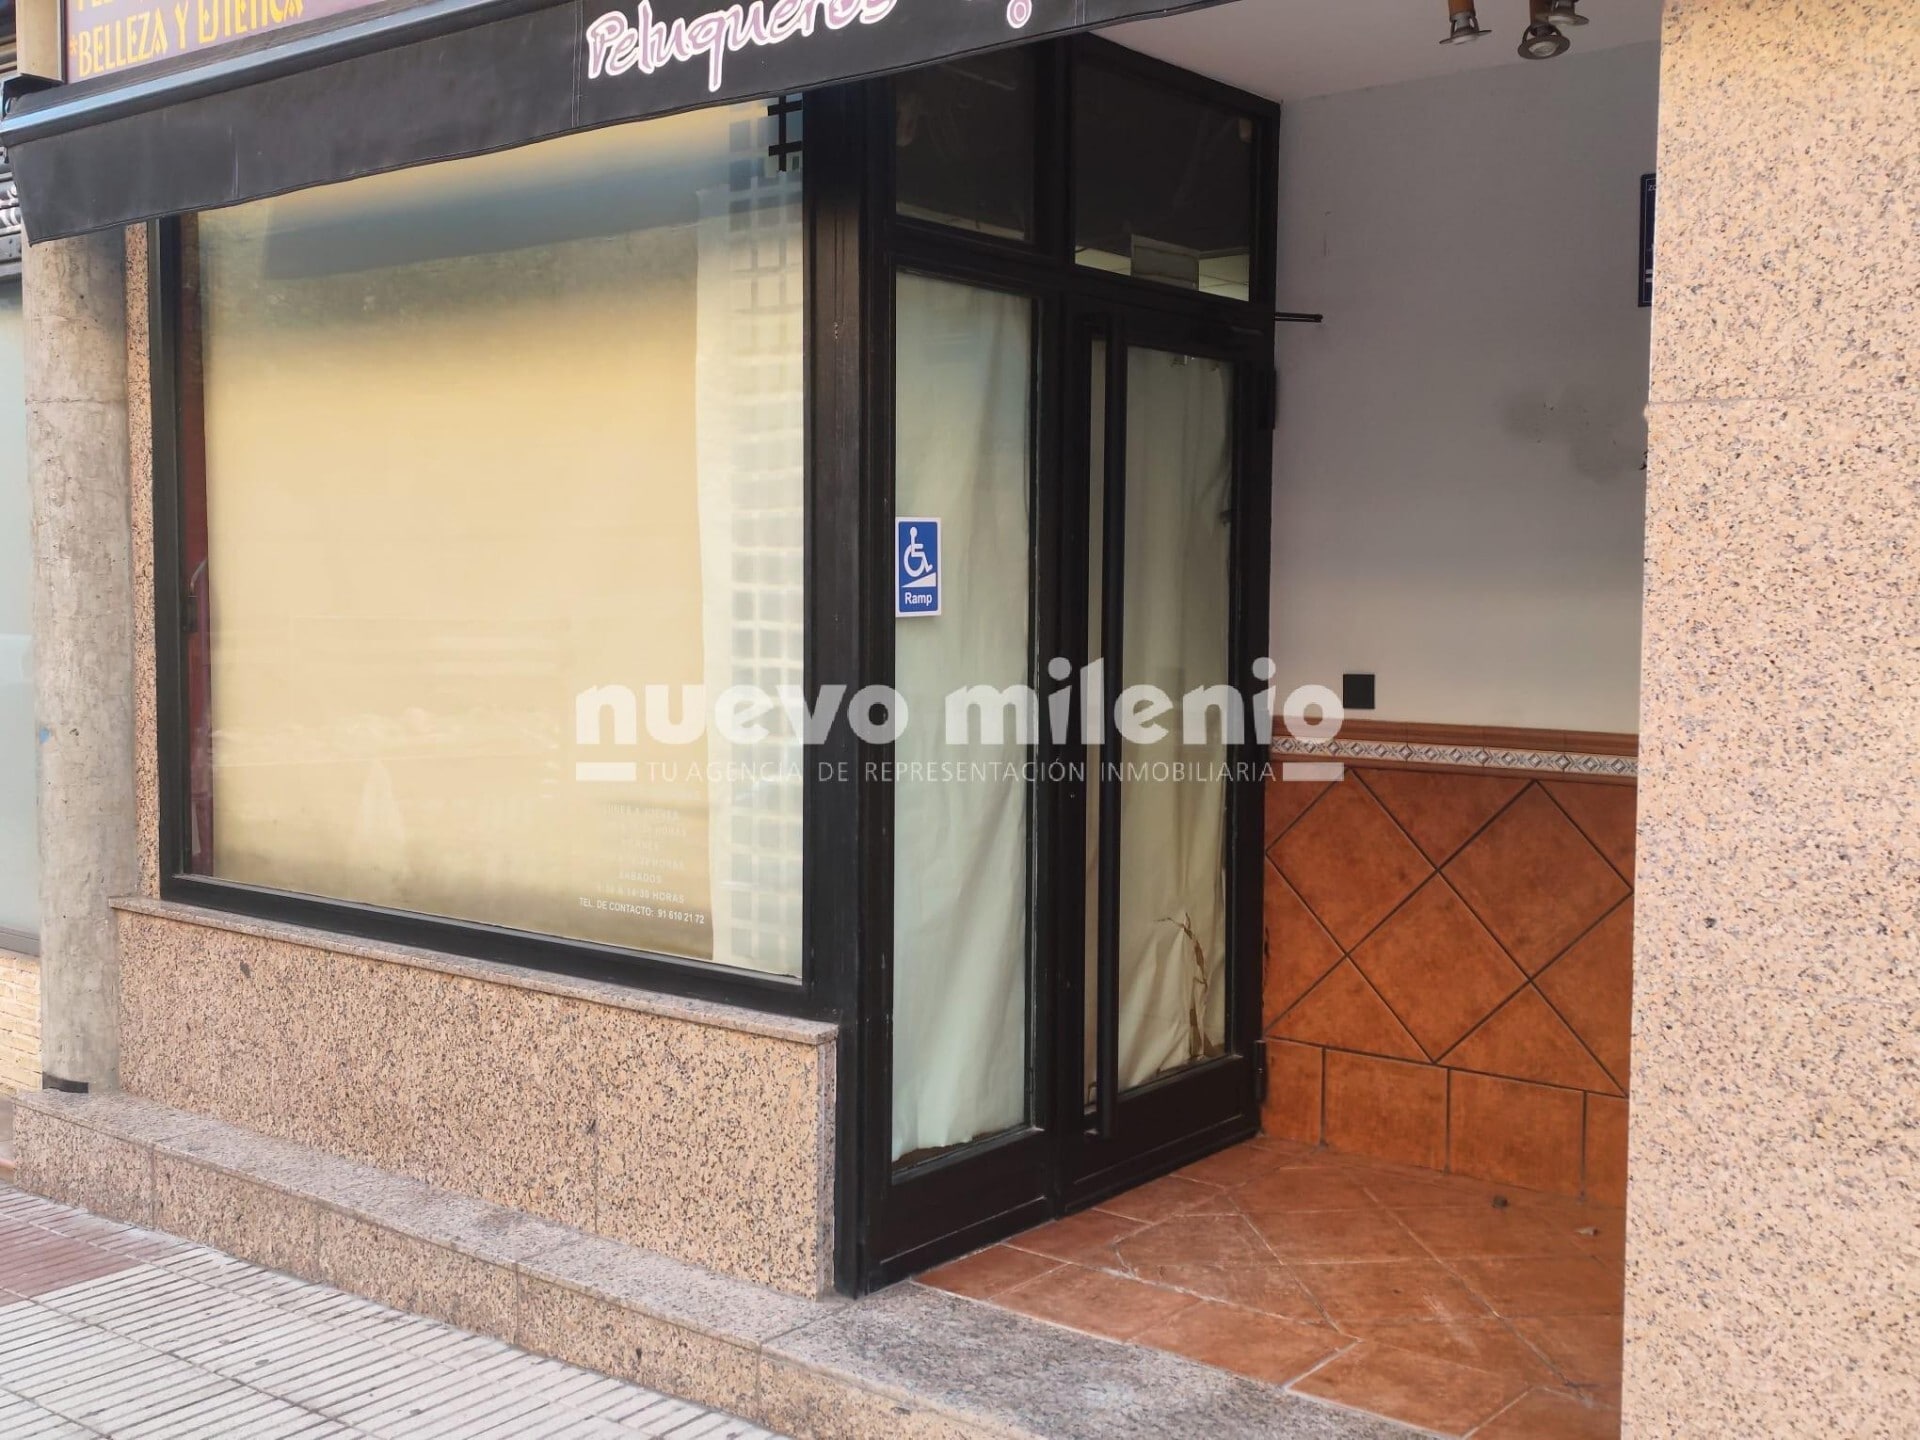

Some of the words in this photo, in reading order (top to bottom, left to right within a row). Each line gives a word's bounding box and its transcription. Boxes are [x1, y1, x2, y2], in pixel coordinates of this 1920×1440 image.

[79, 8, 168, 77] BELLEZA
[174, 2, 190, 49] Y
[904, 592, 933, 606] Ramp
[652, 891, 686, 904] HORAS
[597, 899, 608, 910] DE
[609, 902, 654, 917] CONTACTO:
[657, 909, 667, 919] 91
[668, 910, 683, 921] 610
[684, 912, 694, 923] 21
[695, 914, 705, 925] 72
